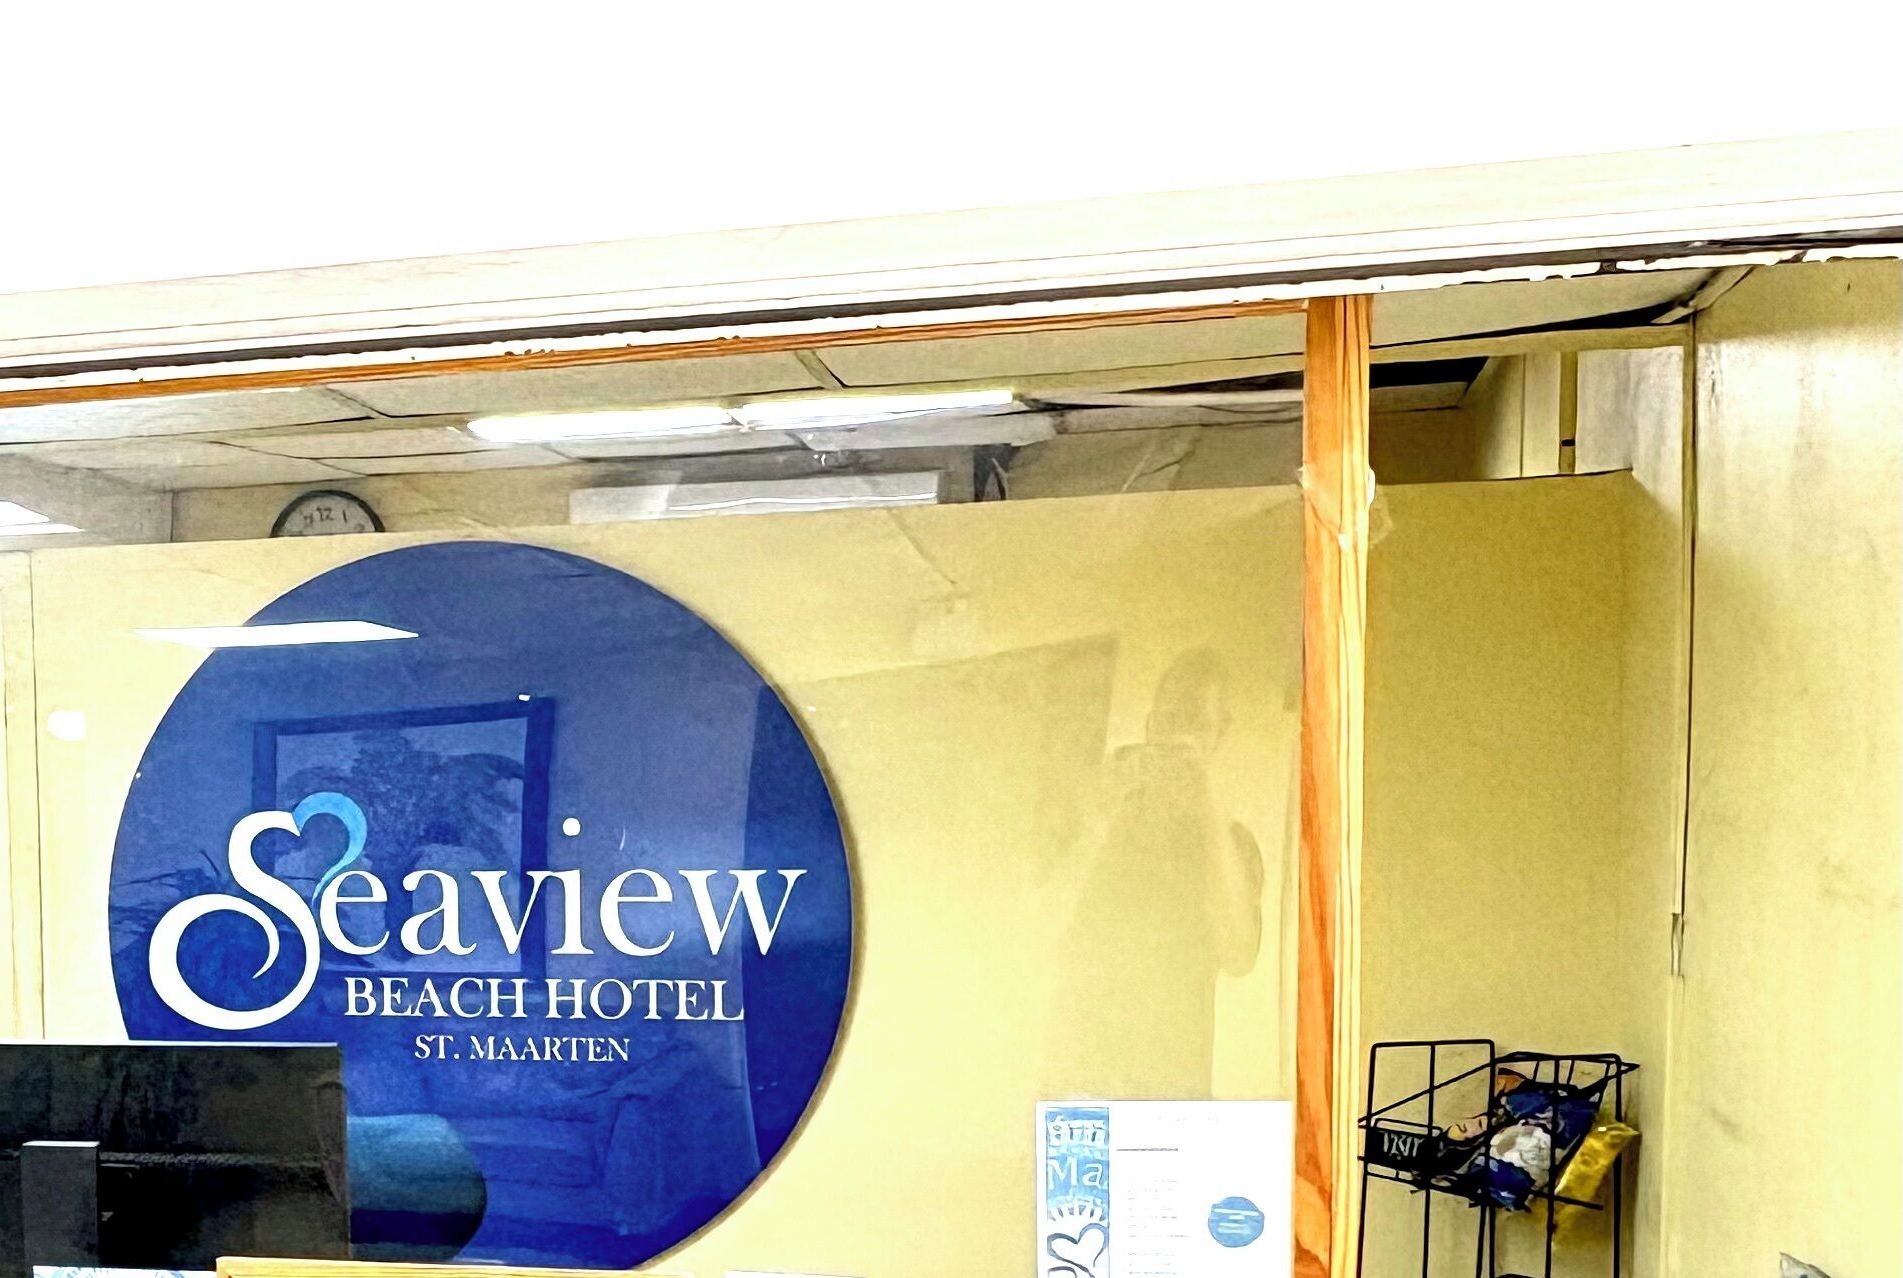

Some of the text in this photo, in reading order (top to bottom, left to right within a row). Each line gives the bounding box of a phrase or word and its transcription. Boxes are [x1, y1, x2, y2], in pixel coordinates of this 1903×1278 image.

[148, 791, 808, 1031] Seaview
[344, 976, 746, 1022] BEACH HOTEL
[414, 1034, 631, 1064] ST. MAARTEN
